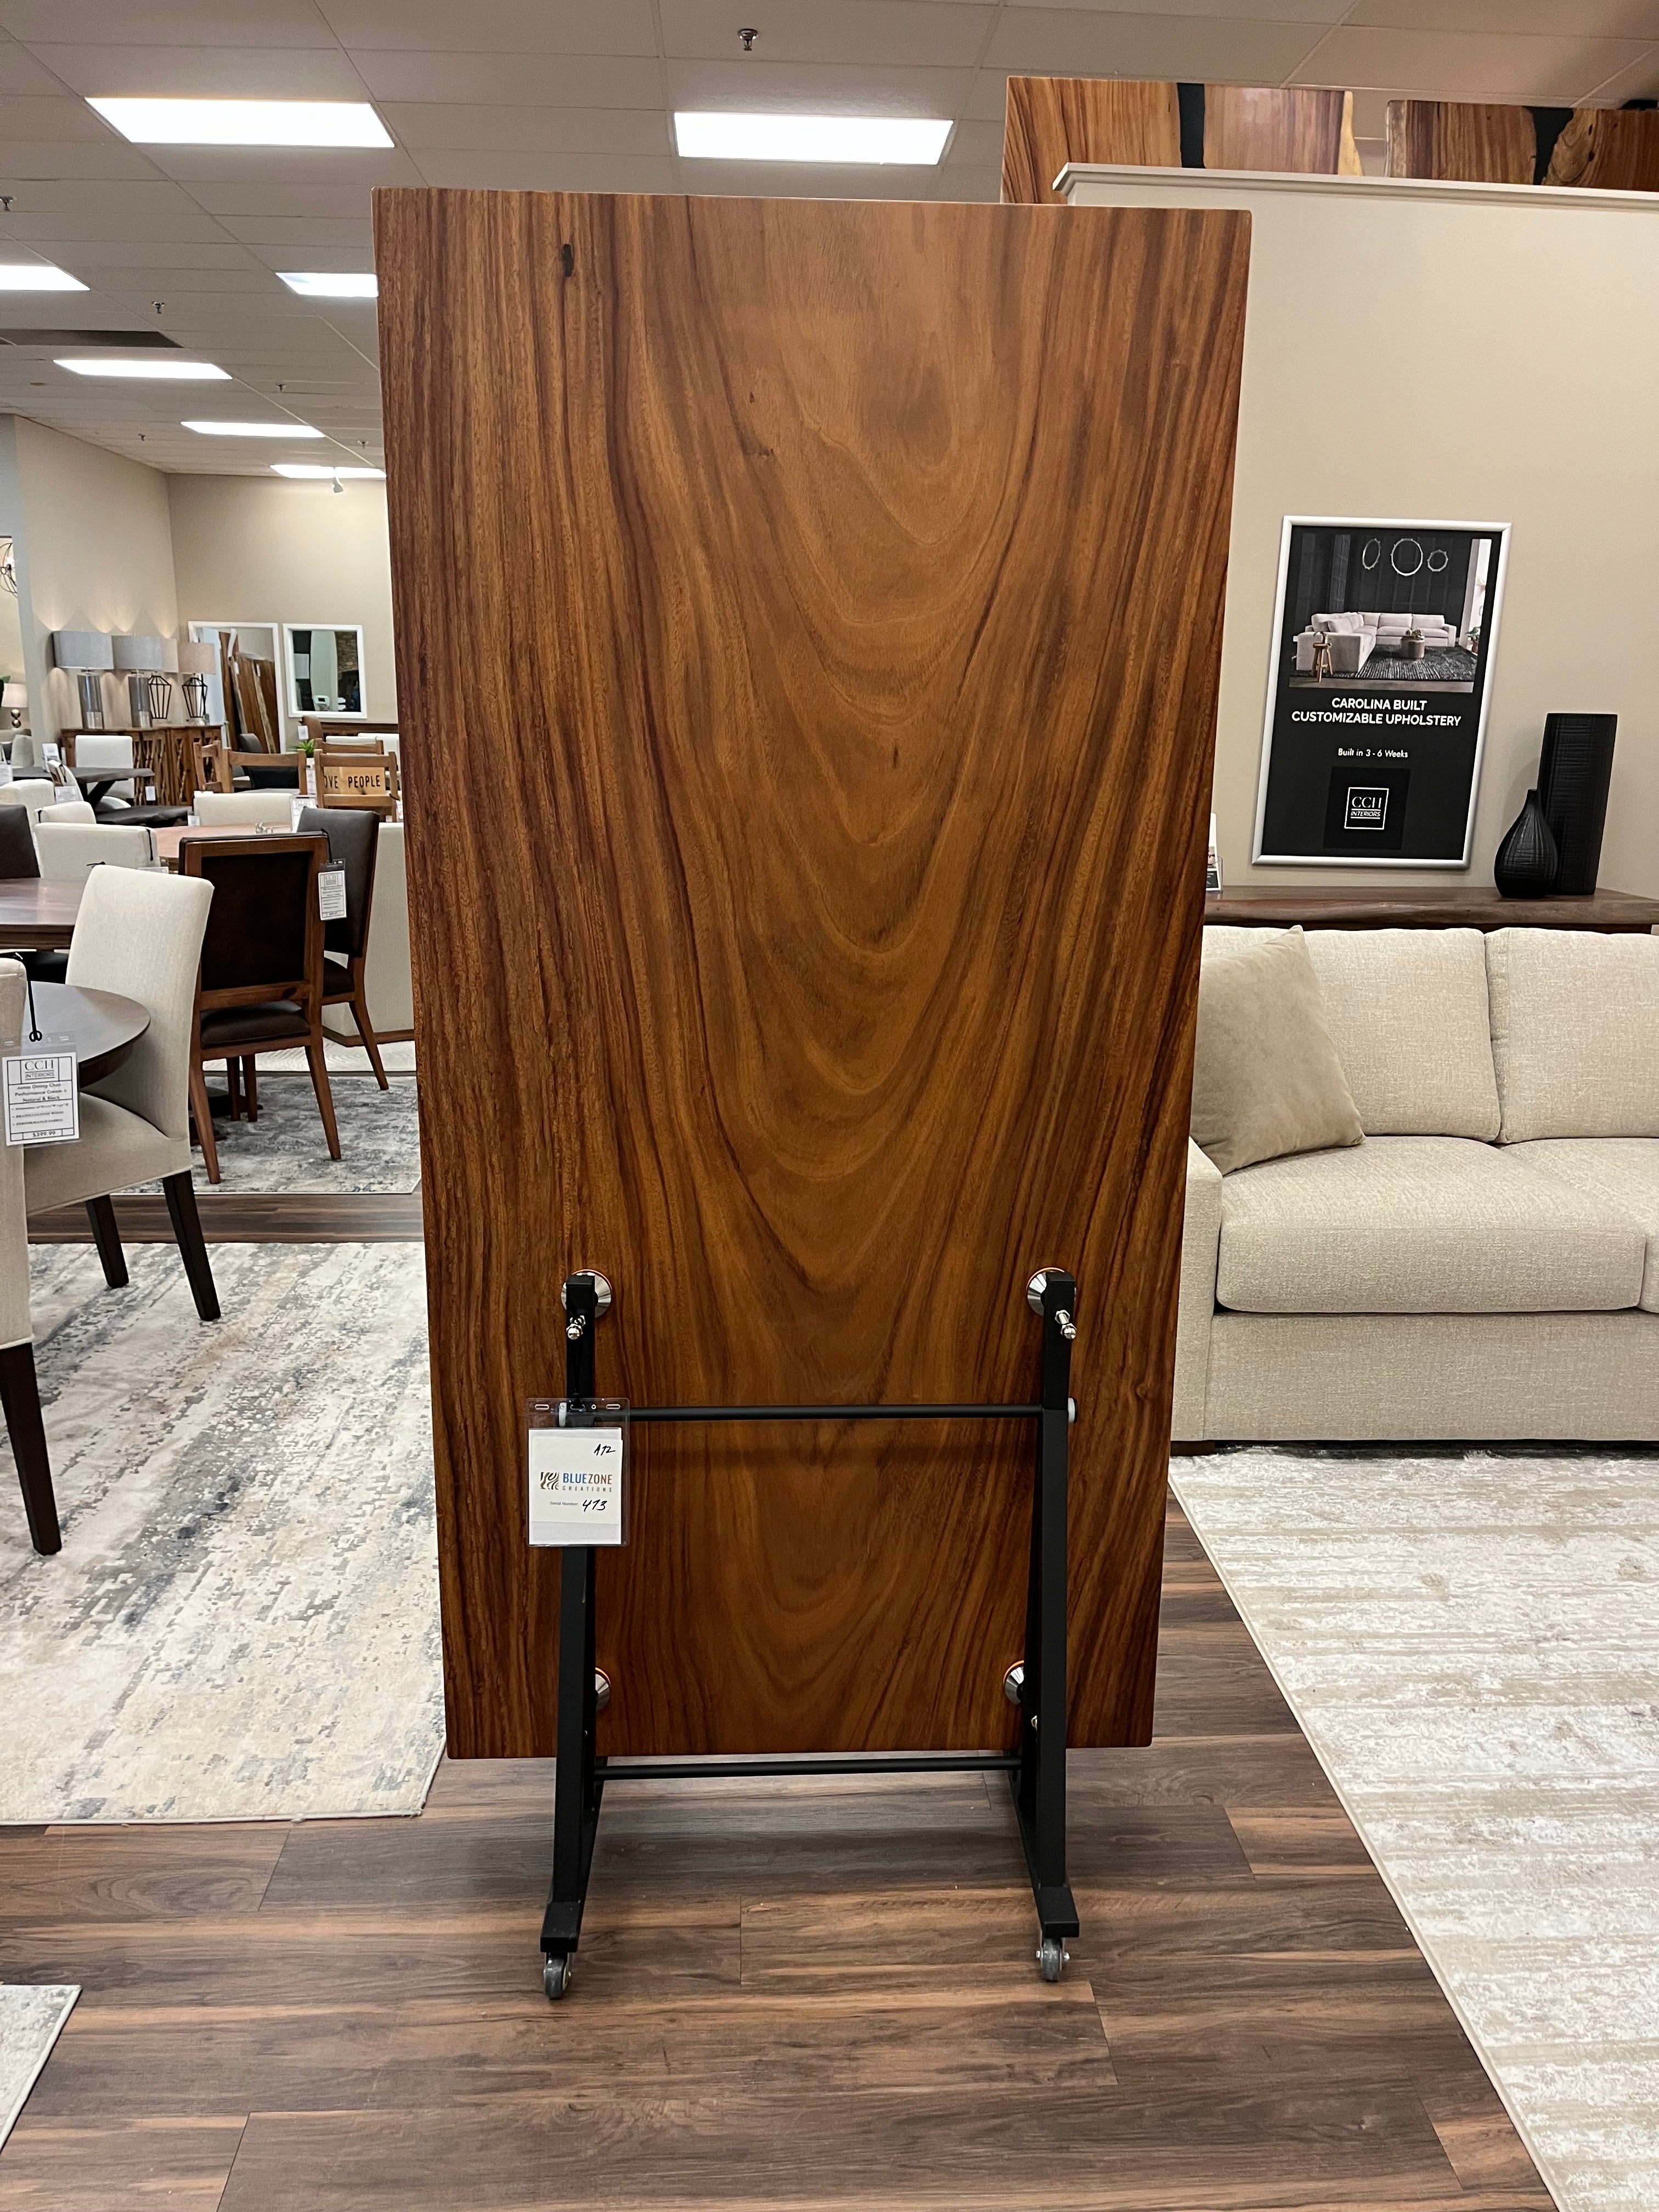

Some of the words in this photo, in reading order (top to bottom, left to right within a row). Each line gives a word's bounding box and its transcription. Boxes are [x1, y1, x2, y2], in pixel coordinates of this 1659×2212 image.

[1331, 697, 1391, 710] CAROLINA
[1393, 699, 1427, 710] BUILT
[1291, 711, 1383, 724] CUSTOMIZABLE
[1385, 714, 1462, 726] UPHOLSTERY
[1338, 748, 1355, 757] Built
[1356, 748, 1363, 757] in
[1385, 749, 1408, 758] Weeks
[348, 775, 381, 788] PEOPLE
[1352, 796, 1382, 808] CCH
[25, 1059, 54, 1071] CCH
[563, 1472, 613, 1485] BLUEZONE
